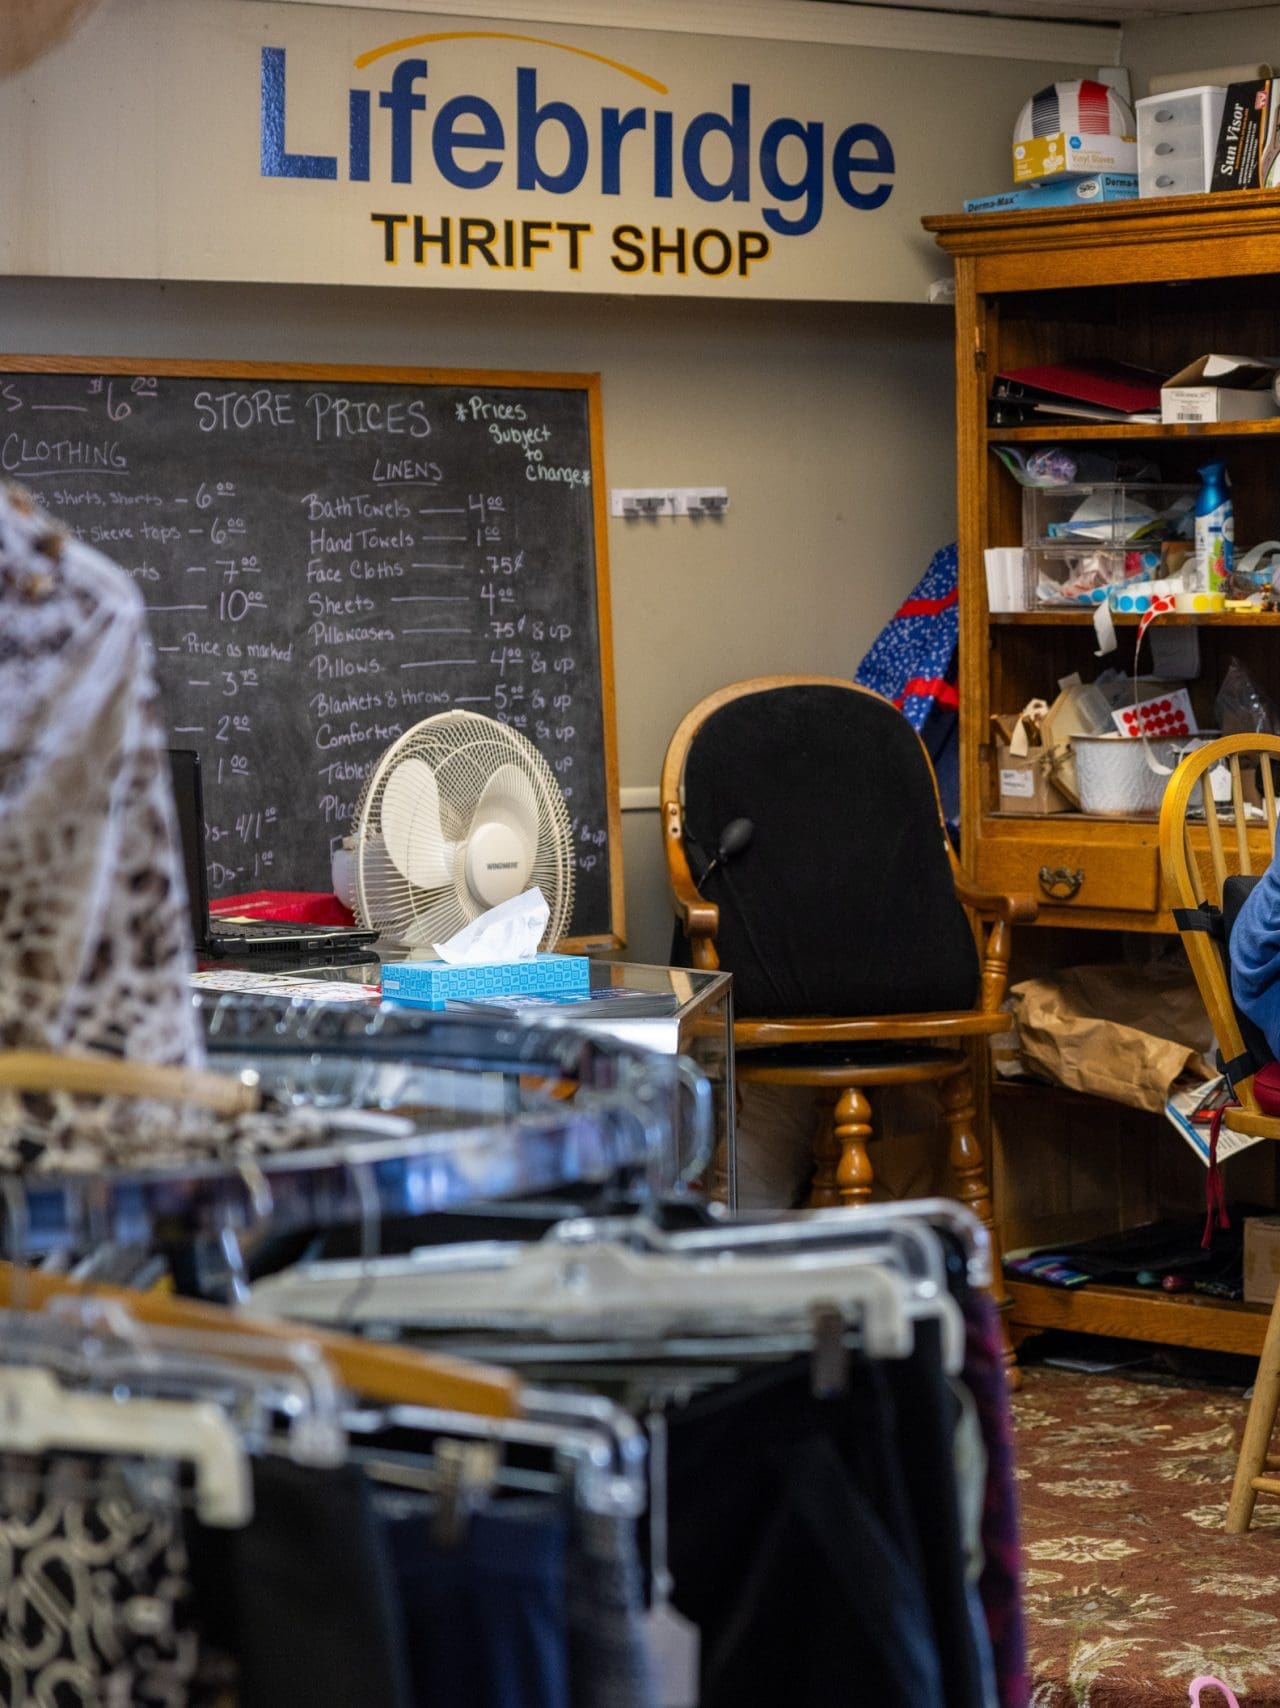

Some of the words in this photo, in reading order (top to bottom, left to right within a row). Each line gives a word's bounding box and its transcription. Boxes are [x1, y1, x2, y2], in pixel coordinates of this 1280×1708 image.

[1226, 102, 1245, 141] Visor
[260, 45, 896, 236] Lifebridge
[1221, 145, 1238, 176] Sun
[370, 212, 593, 270] THRIFT
[609, 222, 772, 280] SHOP
[194, 390, 295, 432] STORE
[305, 392, 432, 441] PRICES
[2, 432, 128, 470] CLOTHING
[525, 448, 544, 462] to
[372, 459, 443, 481] LINENS
[301, 493, 352, 521] Bath
[351, 494, 411, 519] Towels
[142, 521, 181, 544] tops
[309, 528, 353, 554] Hand
[356, 528, 415, 549] Towels
[306, 558, 343, 584] Face
[350, 559, 405, 581] Cloths
[307, 592, 376, 619] Sheets
[550, 623, 572, 641] up
[226, 645, 243, 658] as
[309, 654, 381, 681] Pillows
[554, 656, 575, 674] up
[309, 692, 382, 718] Blankets
[553, 691, 572, 711] up
[554, 725, 576, 743] up
[555, 756, 574, 774] up
